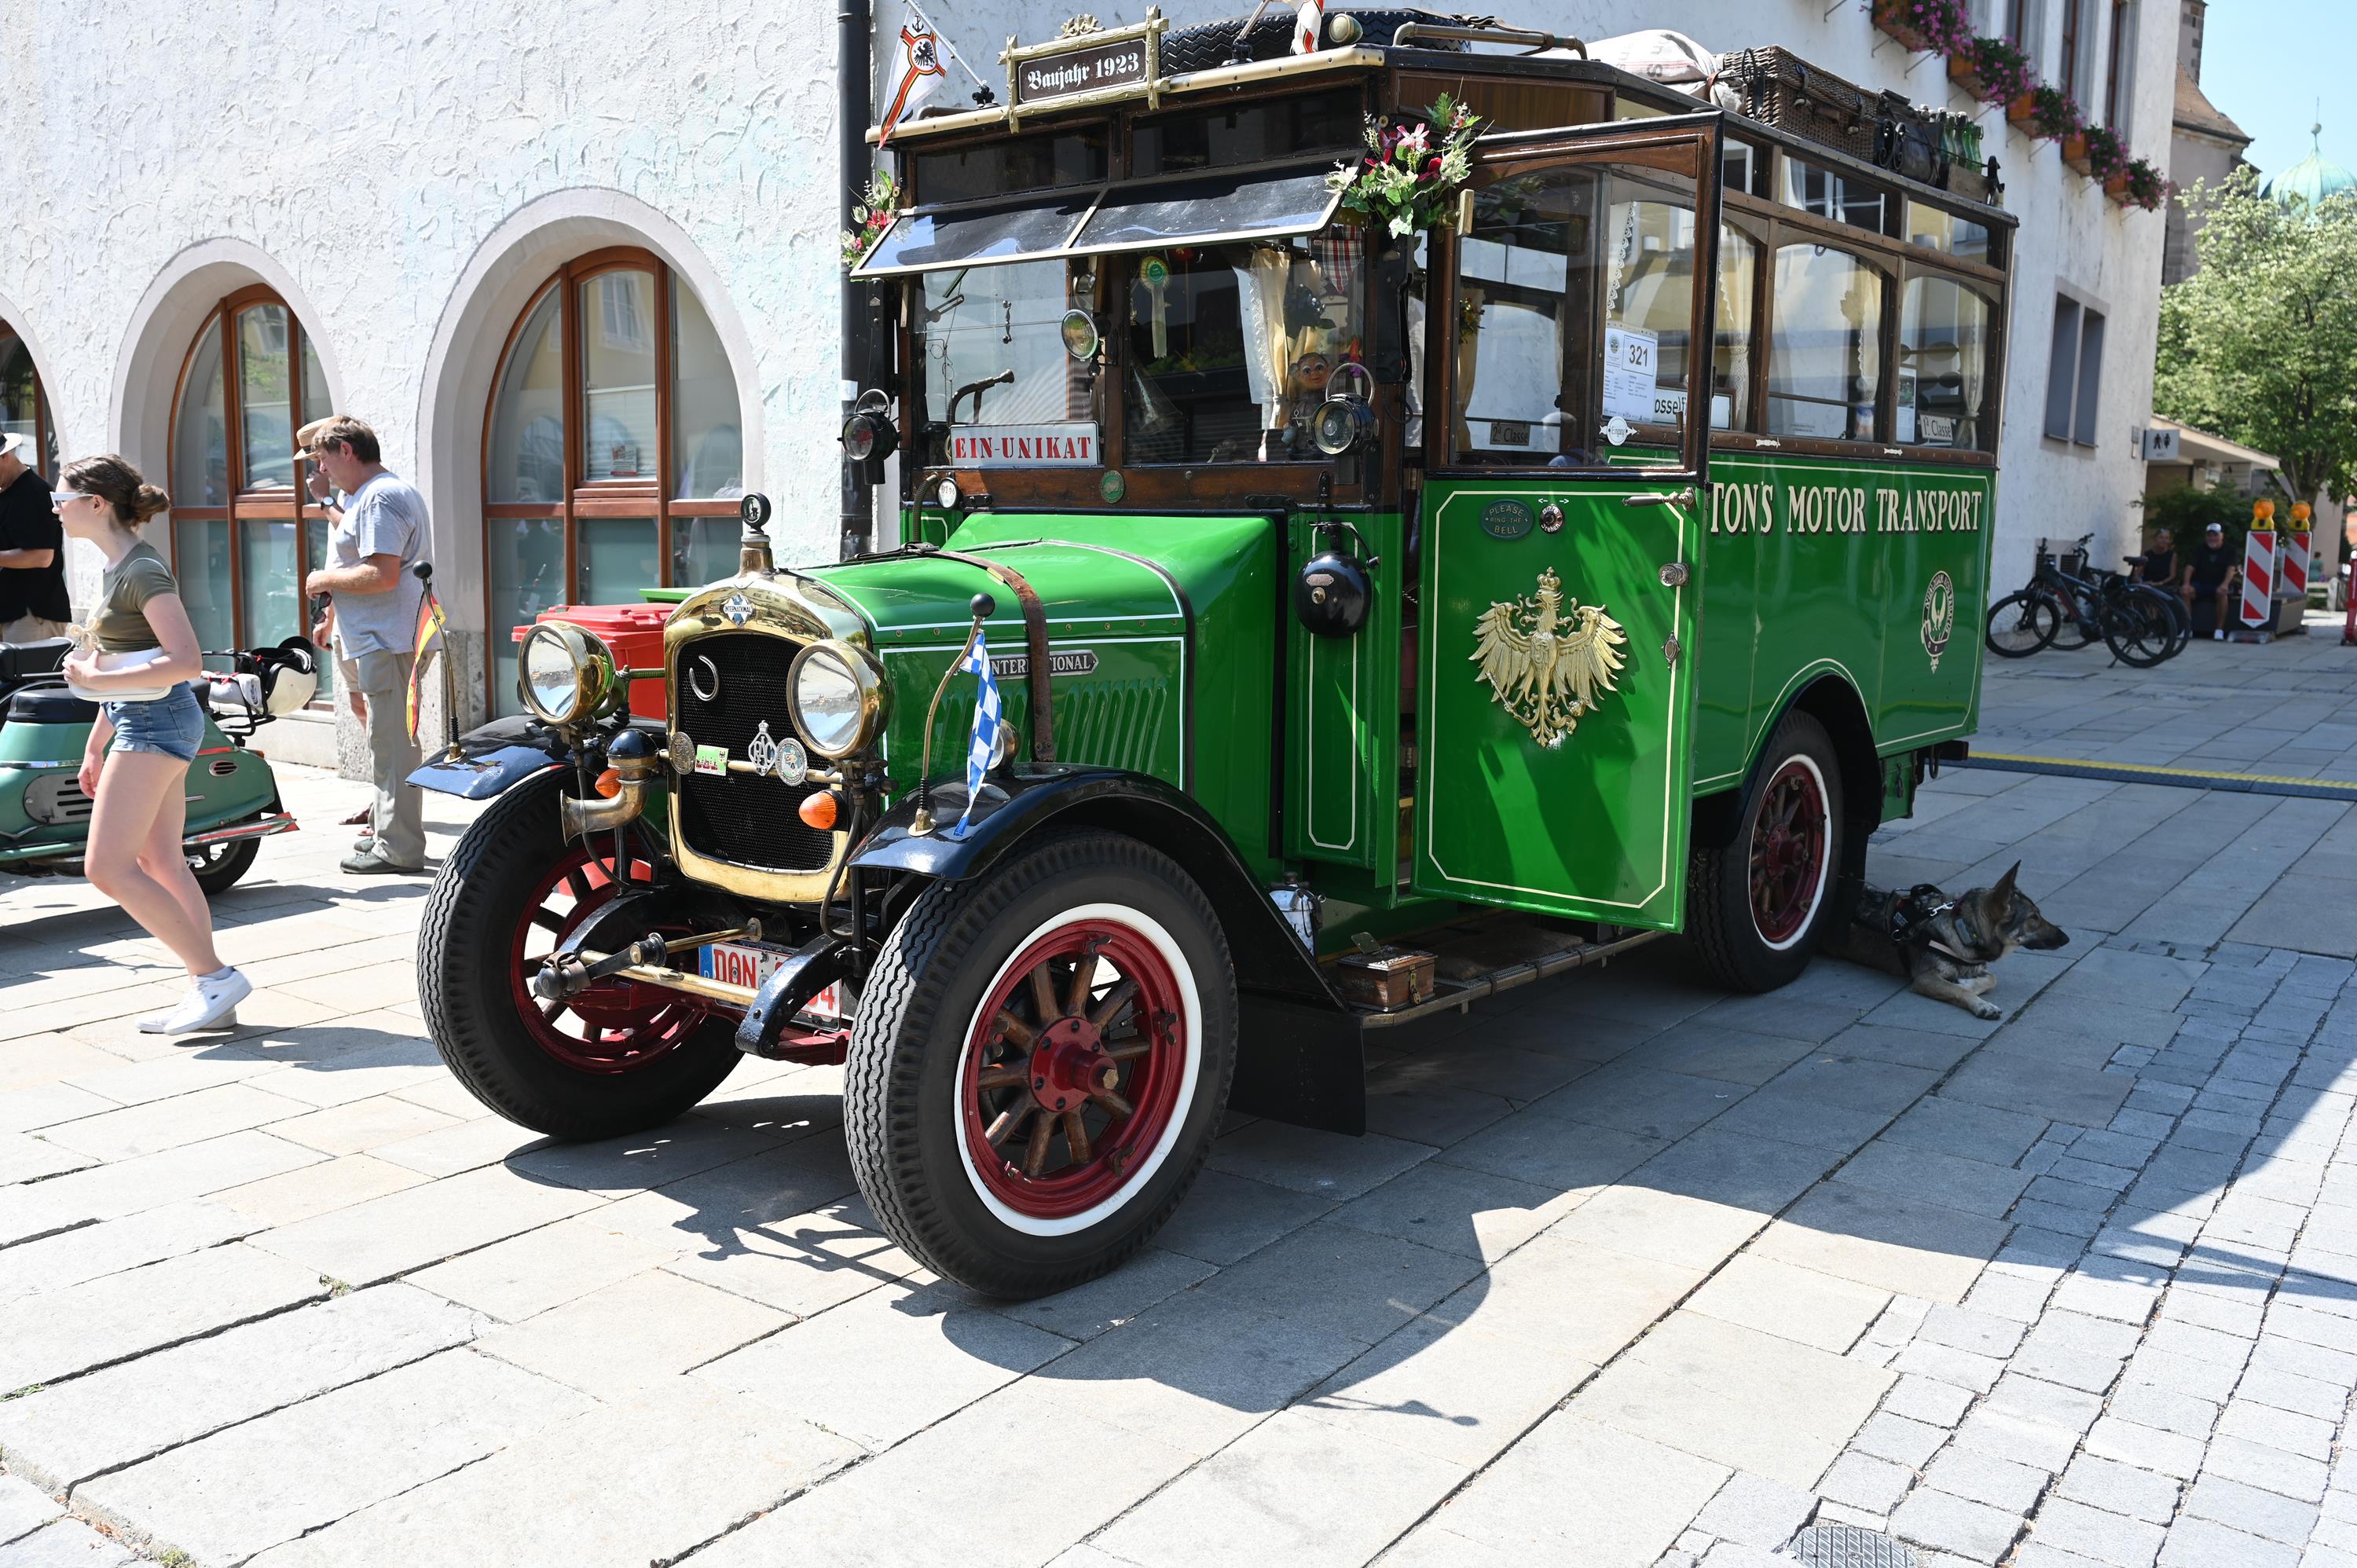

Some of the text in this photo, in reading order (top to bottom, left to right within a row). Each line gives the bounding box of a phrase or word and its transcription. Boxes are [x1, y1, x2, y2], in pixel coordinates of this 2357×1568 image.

[1028, 52, 1139, 90] Baujahr 1923
[1629, 344, 1648, 367] 321
[1504, 427, 1528, 444] Classe
[1932, 419, 1952, 438] Classe
[955, 437, 1091, 459] EIN-UNIKAT
[1489, 504, 1524, 516] PLEASE
[1787, 485, 1866, 533] MOTOR
[1876, 489, 1982, 532] TRANSPORT
[1494, 525, 1518, 534] BELL
[713, 948, 757, 988] DON
